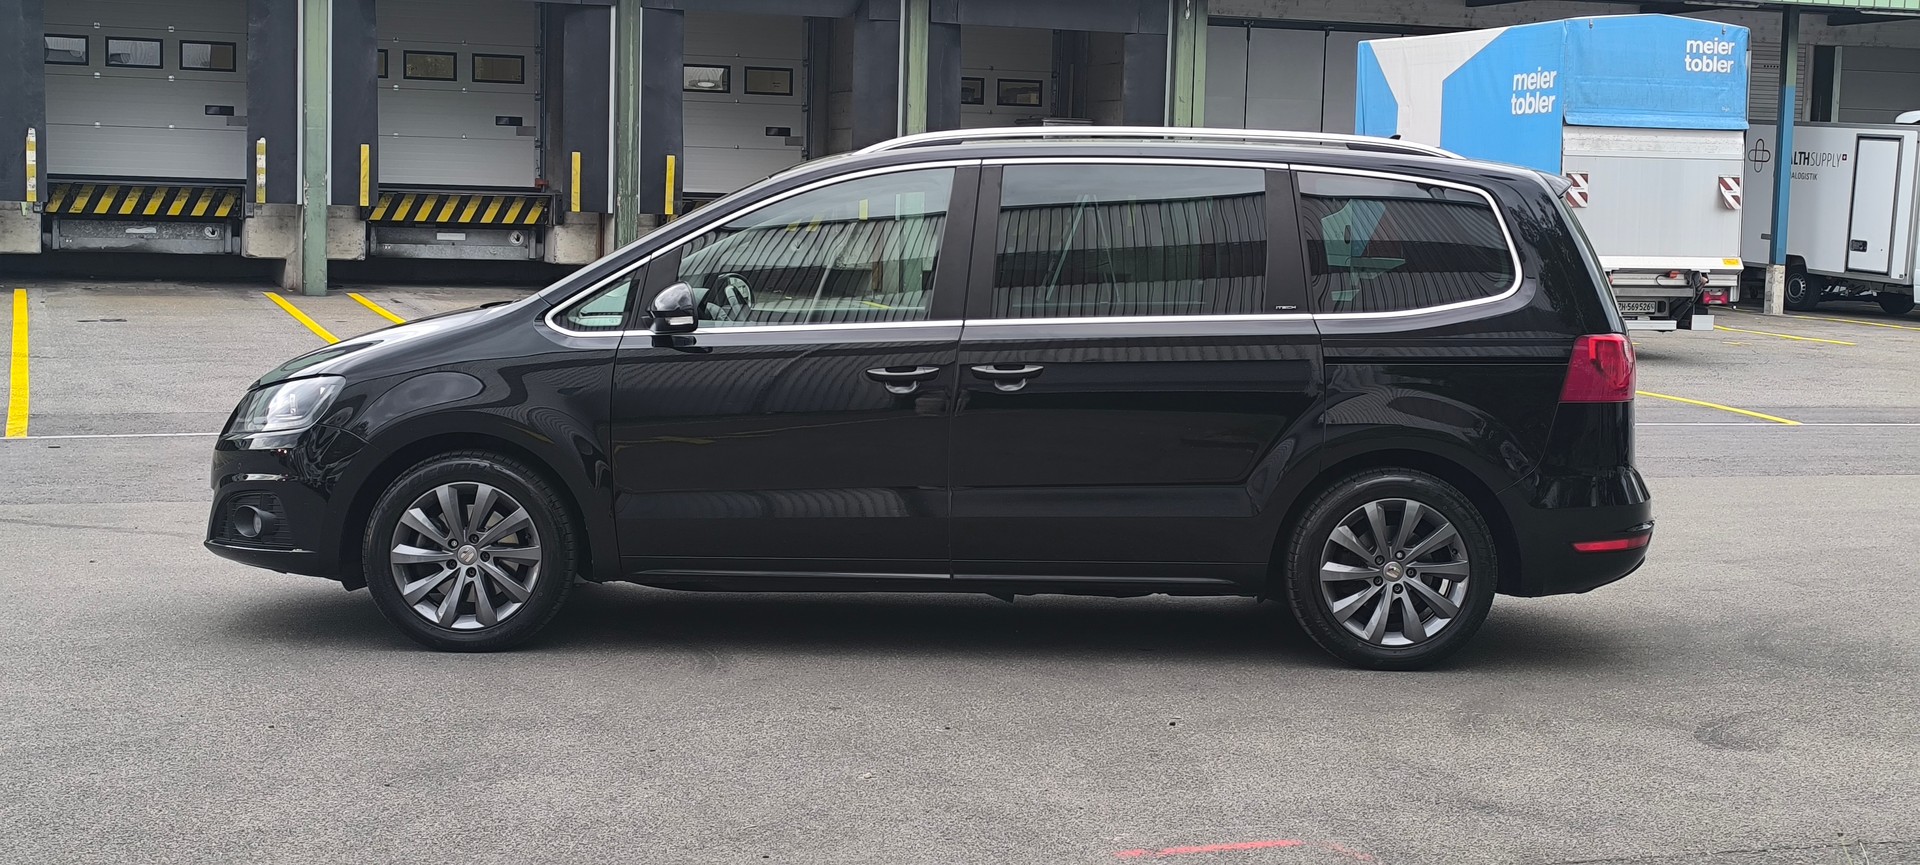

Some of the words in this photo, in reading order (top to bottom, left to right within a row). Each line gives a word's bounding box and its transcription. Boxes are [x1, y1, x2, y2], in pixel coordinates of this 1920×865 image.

[1686, 37, 1735, 55] meier
[1685, 55, 1734, 73] tobler
[1513, 67, 1557, 91] meier
[1511, 92, 1556, 115] tobler
